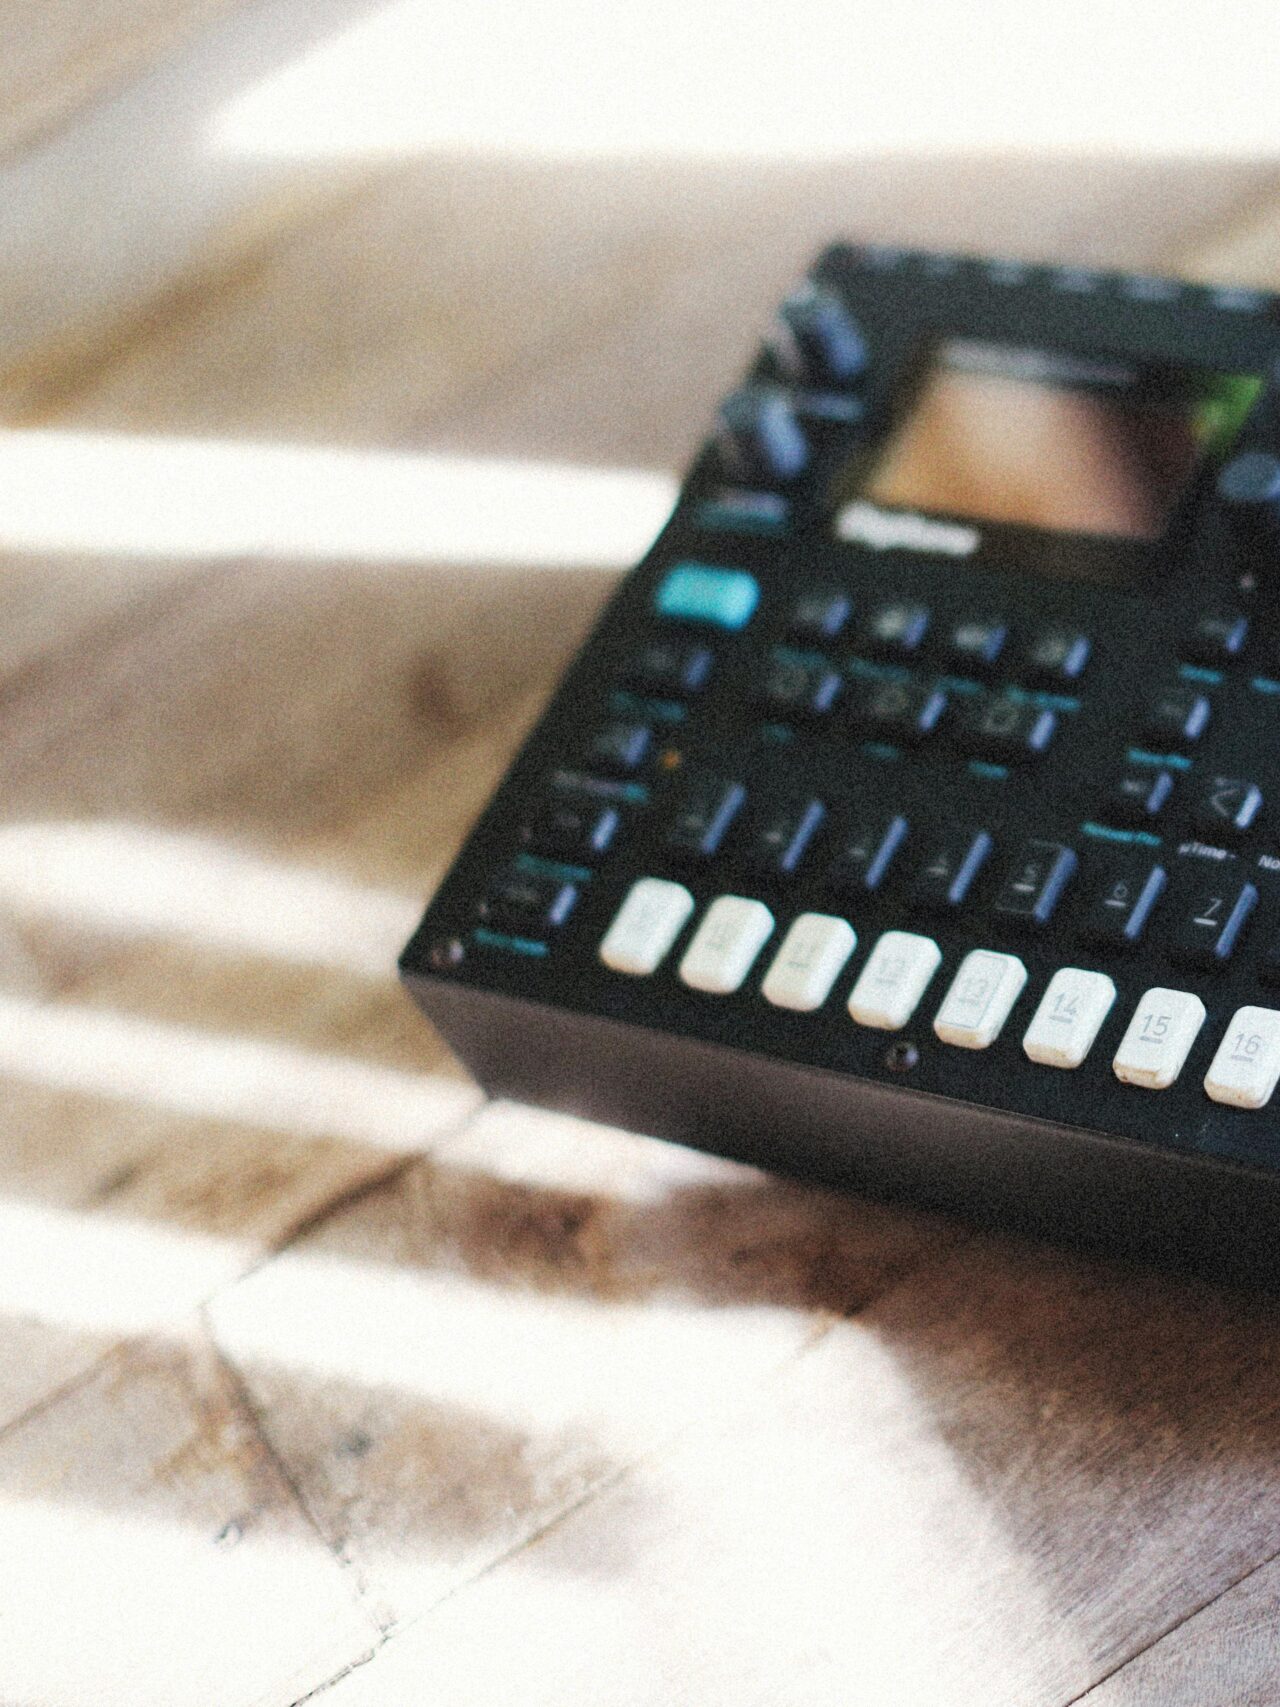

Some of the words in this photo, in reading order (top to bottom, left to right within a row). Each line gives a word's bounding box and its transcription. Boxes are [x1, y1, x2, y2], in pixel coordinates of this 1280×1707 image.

[1202, 898, 1222, 917] 7
[1053, 992, 1078, 1017] 14
[1143, 1014, 1172, 1036] 15
[1232, 1032, 1262, 1056] 16
